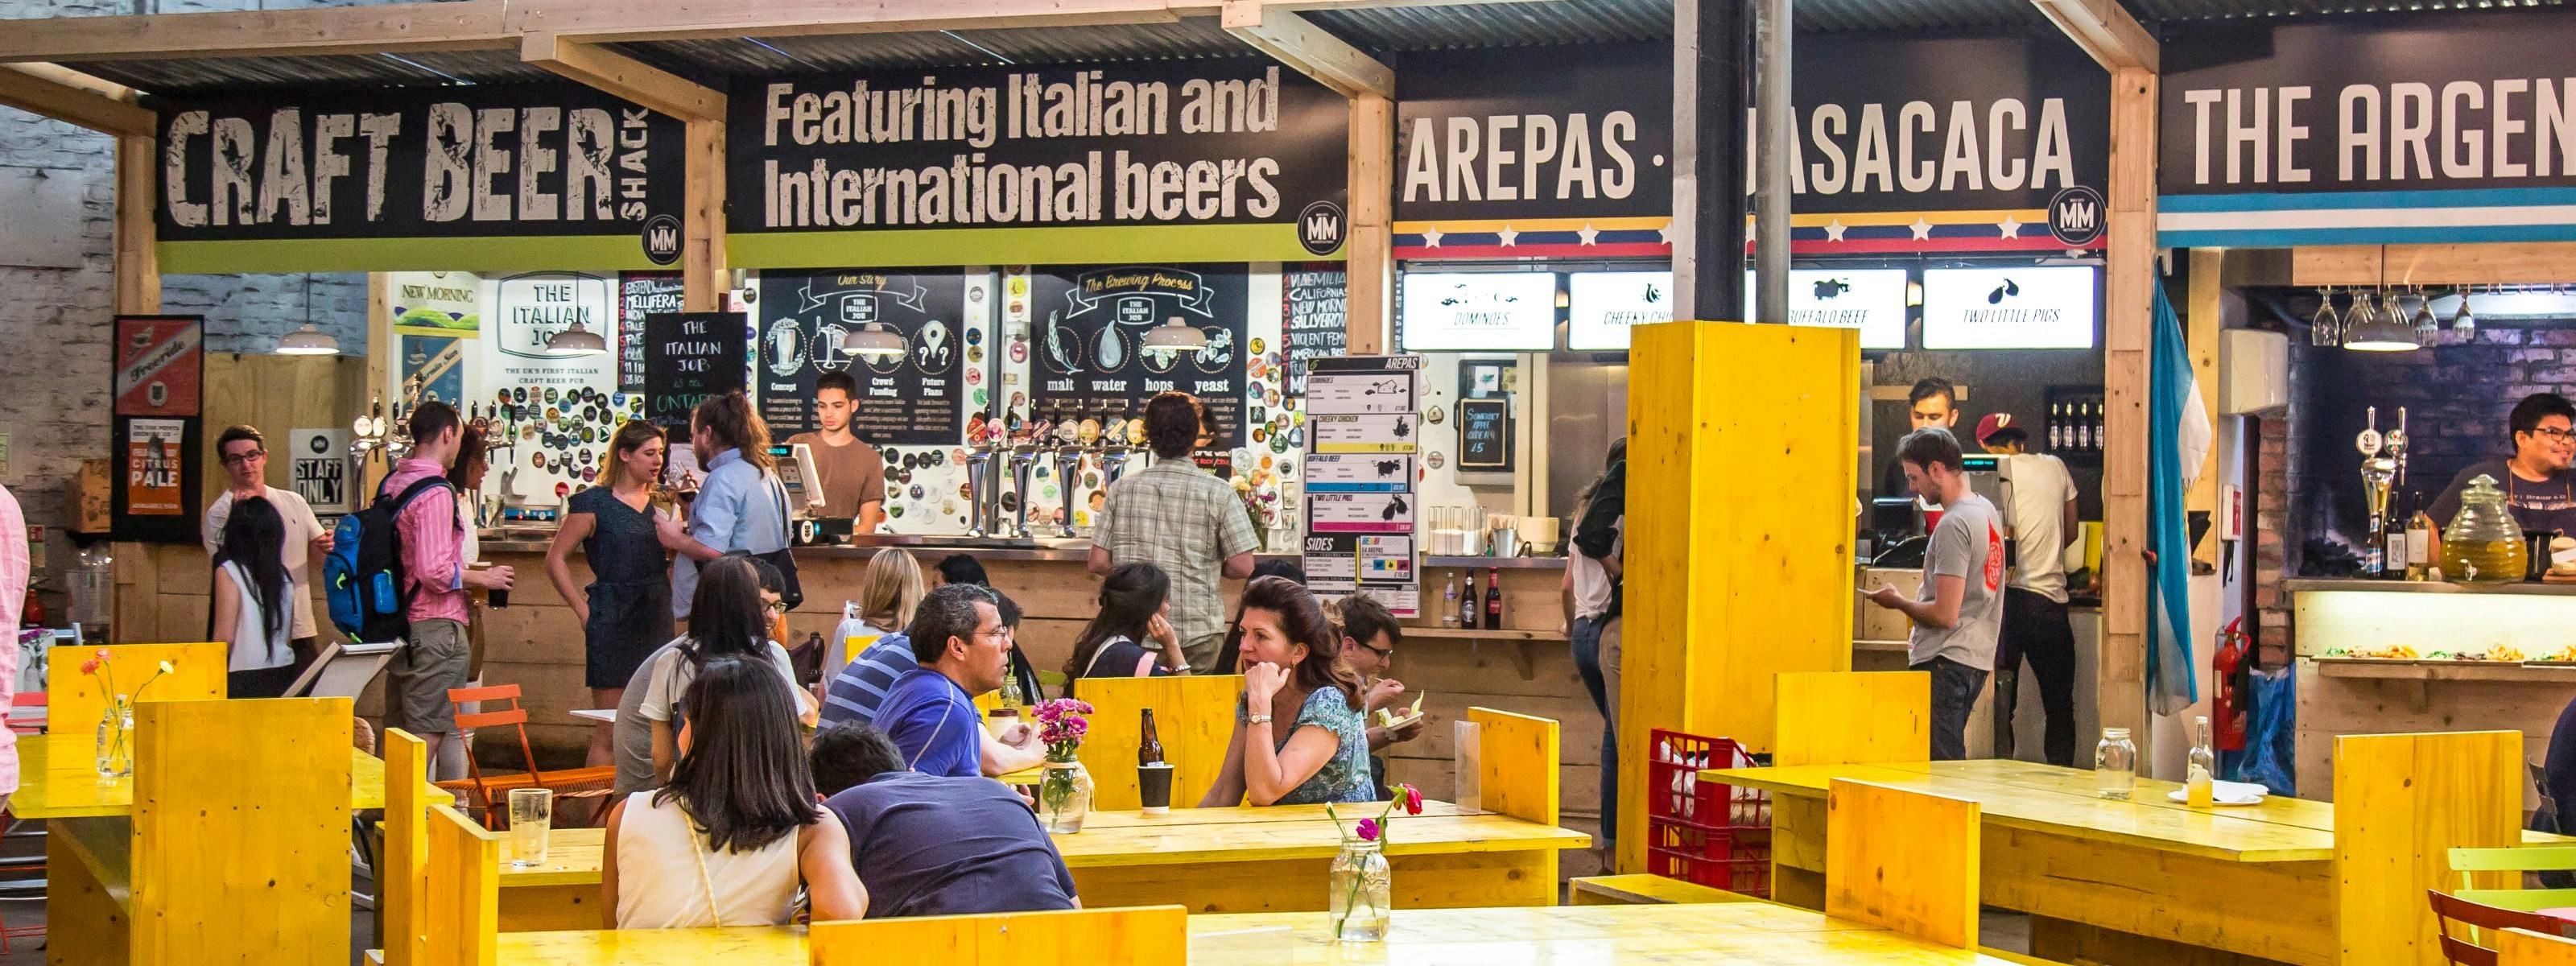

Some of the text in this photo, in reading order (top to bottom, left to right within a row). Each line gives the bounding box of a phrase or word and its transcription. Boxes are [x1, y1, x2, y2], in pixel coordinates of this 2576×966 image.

[765, 66, 1279, 147] Featuring Italian and
[2186, 77, 2576, 184] THE ARGEN
[1404, 110, 1637, 202] AREPAS
[166, 103, 614, 227] CRAFT BEER
[620, 108, 649, 221] SHACK
[765, 151, 1280, 228] International beers
[838, 275, 857, 286] Our
[1085, 274, 1193, 292] The Brewing Process
[402, 285, 473, 303] NEW MORNING
[534, 284, 572, 302] THE
[513, 306, 592, 324] ITALIAN
[1292, 301, 1315, 316] NEW
[2033, 308, 2061, 323] PIGS
[1454, 312, 1511, 325] DOMINOES
[683, 320, 708, 335] THE
[532, 328, 567, 345] JO
[665, 341, 721, 355] ITALIAN
[130, 341, 186, 382] Freeride
[1385, 358, 1418, 369] AREPAS
[1046, 378, 1075, 391] malt
[1092, 379, 1127, 391] water
[1145, 378, 1174, 394] hops
[1195, 378, 1229, 394] yeast
[132, 459, 178, 469] CITRUS
[296, 459, 342, 479] STAFF
[131, 471, 178, 487] PALE
[297, 480, 341, 504] ONLY
[1306, 538, 1334, 551] SIDES
